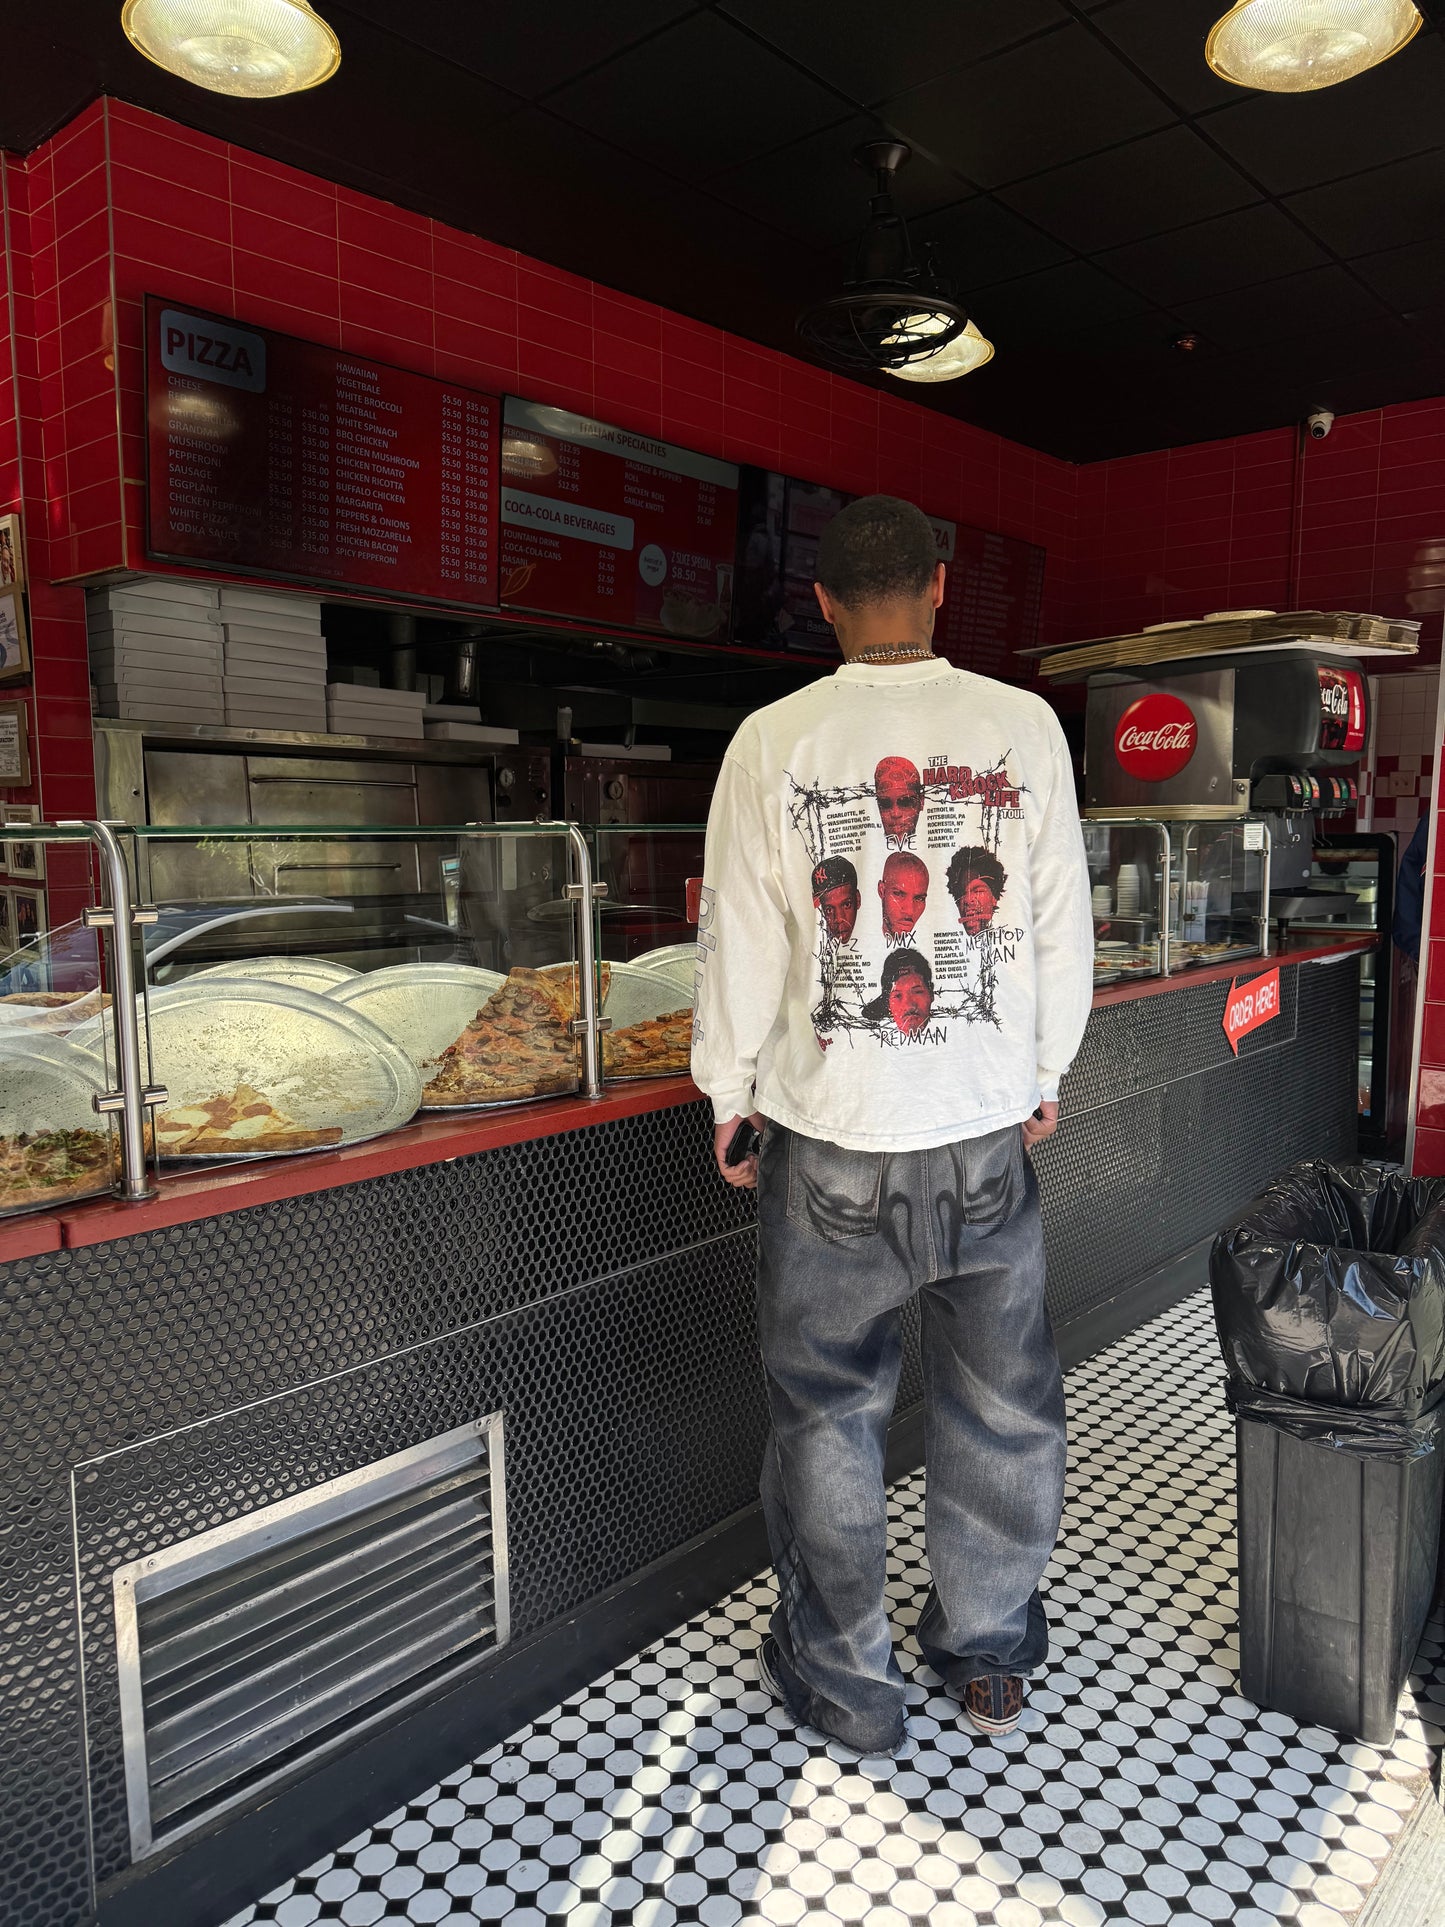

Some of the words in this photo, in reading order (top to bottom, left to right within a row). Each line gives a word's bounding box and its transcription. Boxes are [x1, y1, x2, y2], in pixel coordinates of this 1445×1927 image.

[167, 327, 253, 377] PIZZA
[168, 376, 203, 391] CHEESE
[336, 362, 378, 381] HAWAIIAN
[442, 394, 461, 406] $5.50
[466, 401, 488, 414] $35.00
[336, 376, 380, 395] VEGETBALE
[442, 407, 461, 419] $5.50
[466, 413, 488, 426] $35.00
[336, 390, 362, 404] WHITE
[364, 396, 402, 414] BROCCOLI
[442, 420, 461, 432] $5.50
[466, 426, 488, 438] $35.00
[168, 419, 220, 440] GRANDMA
[336, 402, 377, 420] MEATBALL
[442, 432, 461, 444] $5.50
[466, 438, 488, 451] $35.00
[336, 416, 362, 430] WHITE
[364, 422, 398, 438] SPINACH
[442, 444, 461, 456] $5.50
[466, 450, 488, 464] $35.00
[580, 422, 614, 442] ITALIAN
[617, 432, 666, 457] SPECIALTIES
[169, 434, 230, 455] MUSHROOM
[336, 428, 354, 441] BBQ
[356, 434, 389, 448] CHICKEN
[442, 457, 461, 469] $5.50
[466, 463, 488, 476] $35.00
[169, 463, 213, 480] SAUSAGE
[336, 442, 370, 458] CHICKEN
[372, 450, 420, 469] MUSHROOM
[442, 470, 461, 481] $5.50
[466, 476, 488, 488] $35.00
[336, 456, 370, 471] CHICKEN
[371, 463, 405, 478] TOMATO
[442, 482, 461, 494] $5.50
[466, 488, 488, 500] $35.00
[169, 477, 219, 496] EGGPLANT
[169, 492, 210, 508] CHICKEN
[336, 469, 370, 483] CHICKEN
[372, 476, 404, 491] RICOTTA
[442, 494, 460, 506] $5.50
[465, 500, 488, 512] $35.00
[336, 482, 371, 496] BUFFALO
[372, 490, 406, 504] CHICKEN
[442, 506, 460, 518] $5.50
[465, 512, 488, 524] $35.00
[170, 506, 200, 520] WHITE
[336, 494, 383, 512] MARGARITA
[442, 519, 460, 530] $5.50
[465, 524, 488, 536] $35.00
[336, 508, 370, 522] PEPPERS
[371, 515, 378, 524] &
[380, 516, 410, 530] ONIONS
[442, 532, 460, 542] $5.50
[465, 536, 488, 548] $35.00
[504, 500, 561, 524] COCA-COLA
[564, 514, 616, 536] BEVERAGES
[336, 521, 360, 534] FRESH
[362, 526, 412, 544] MOZZARELLA
[441, 544, 460, 555] $5.50
[465, 549, 487, 560] $35.00
[504, 528, 538, 544] FOUNTAIN
[336, 534, 370, 548] CHICKEN
[372, 541, 398, 553] BACON
[441, 556, 460, 567] $5.50
[465, 560, 487, 572] $35.00
[336, 546, 356, 558] SPICY
[358, 551, 398, 565] PEPPERONI
[441, 568, 460, 579] $5.50
[465, 573, 487, 584] $35.00
[672, 566, 696, 582] $8.50
[1118, 721, 1196, 752] Coca-Cola
[923, 766, 972, 786] HARD
[928, 755, 948, 768] THE
[950, 770, 1010, 801] KNOCK
[983, 790, 1020, 808] LIFE
[886, 834, 918, 852] EVE
[885, 930, 917, 949] DMX
[966, 924, 1024, 956] METHOD
[980, 944, 1016, 968] MAN
[1229, 994, 1254, 1032] ORDER
[1254, 980, 1277, 1016] HERE!
[880, 1026, 947, 1048] REDMAN
